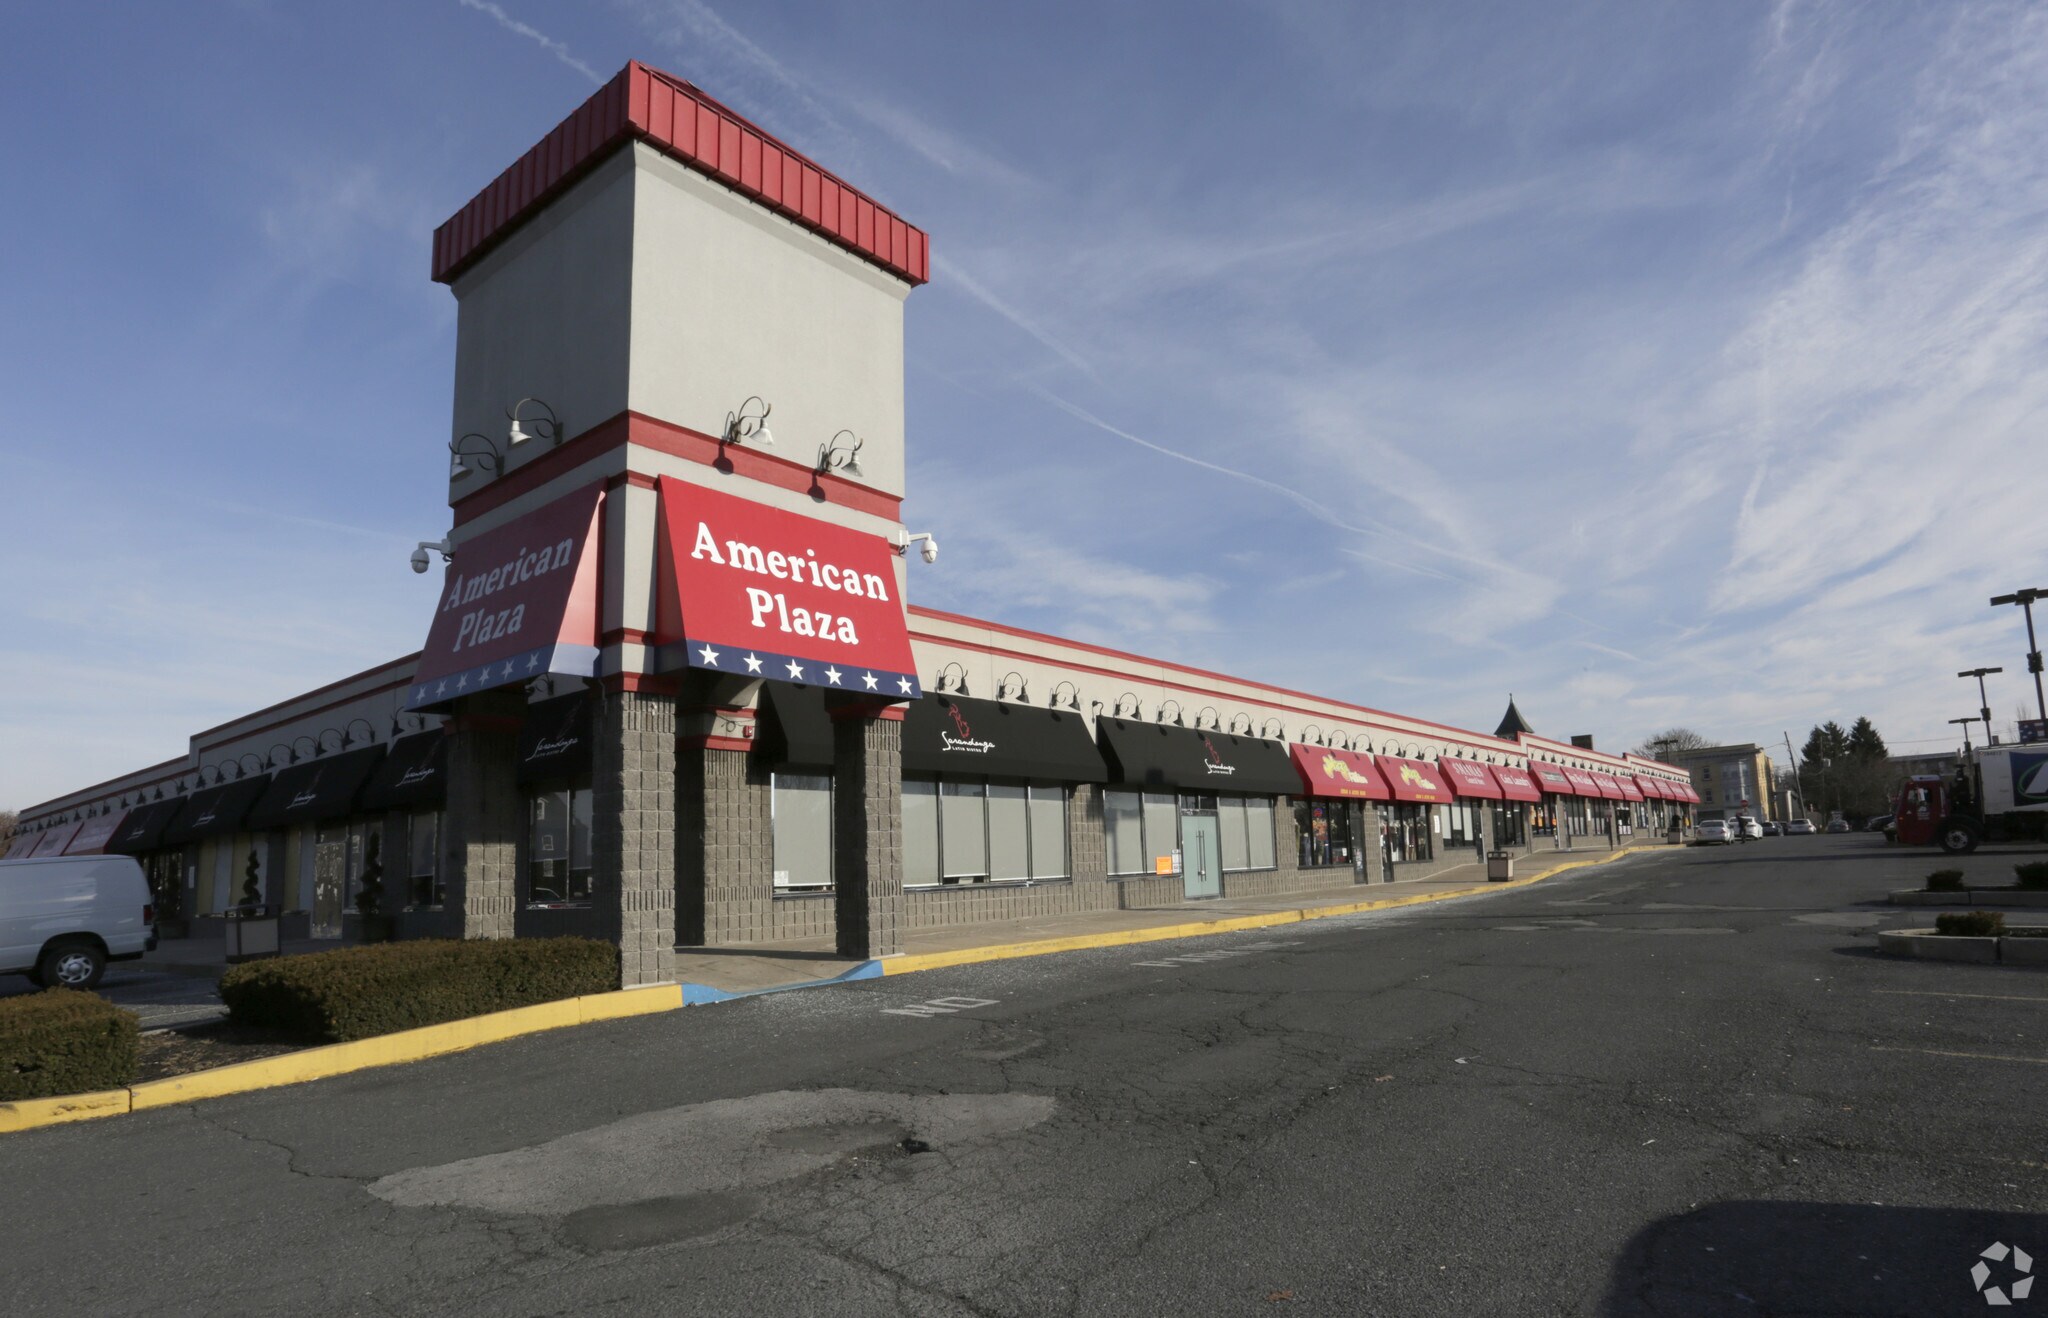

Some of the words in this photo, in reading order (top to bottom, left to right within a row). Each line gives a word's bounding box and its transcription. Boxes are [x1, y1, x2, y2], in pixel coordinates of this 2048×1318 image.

[443, 538, 573, 612] American
[691, 521, 889, 602] American
[452, 603, 525, 653] Plaza
[746, 587, 859, 645] Plaza
